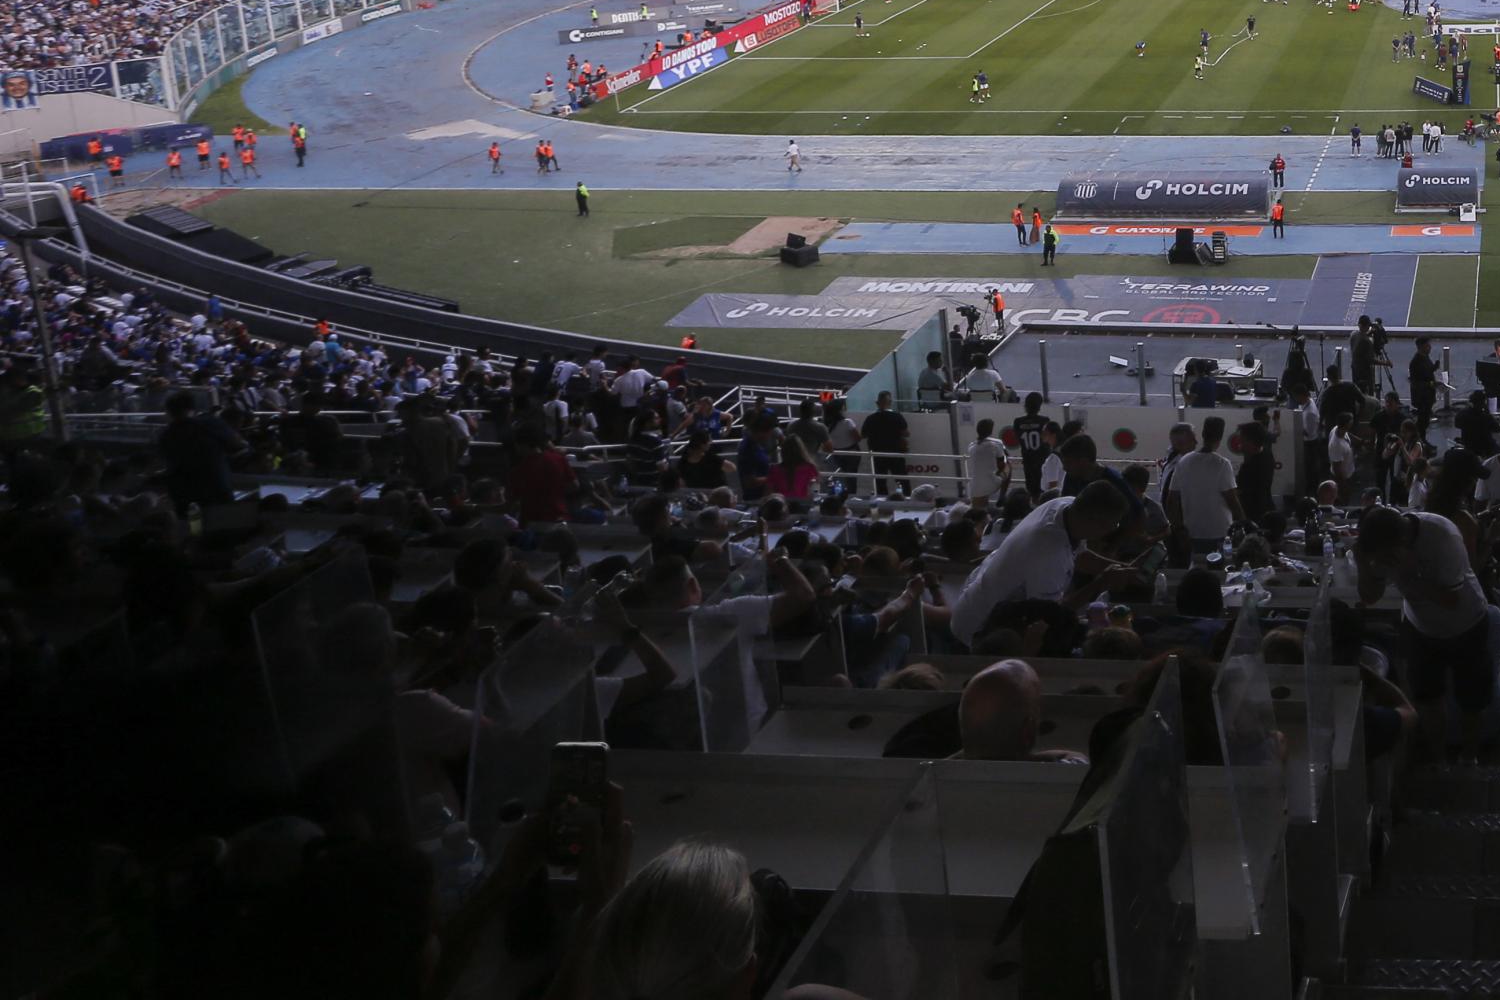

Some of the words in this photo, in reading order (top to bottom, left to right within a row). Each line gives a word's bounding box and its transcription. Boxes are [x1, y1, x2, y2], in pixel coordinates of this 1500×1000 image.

[661, 56, 671, 71] LO
[672, 45, 696, 67] DAMOS
[696, 36, 717, 55] TODO
[671, 53, 714, 80] YPF
[88, 67, 109, 87] 2
[1422, 176, 1471, 186] HOLCIM
[1166, 183, 1249, 196] HOLCIM
[1115, 227, 1206, 235] GATORAE
[858, 282, 1034, 294] MONTIRONI
[1128, 281, 1270, 293] TERRAWIND
[1351, 272, 1373, 302] TALLERES
[767, 306, 879, 318] HOLCIM
[1020, 431, 1041, 451] 10
